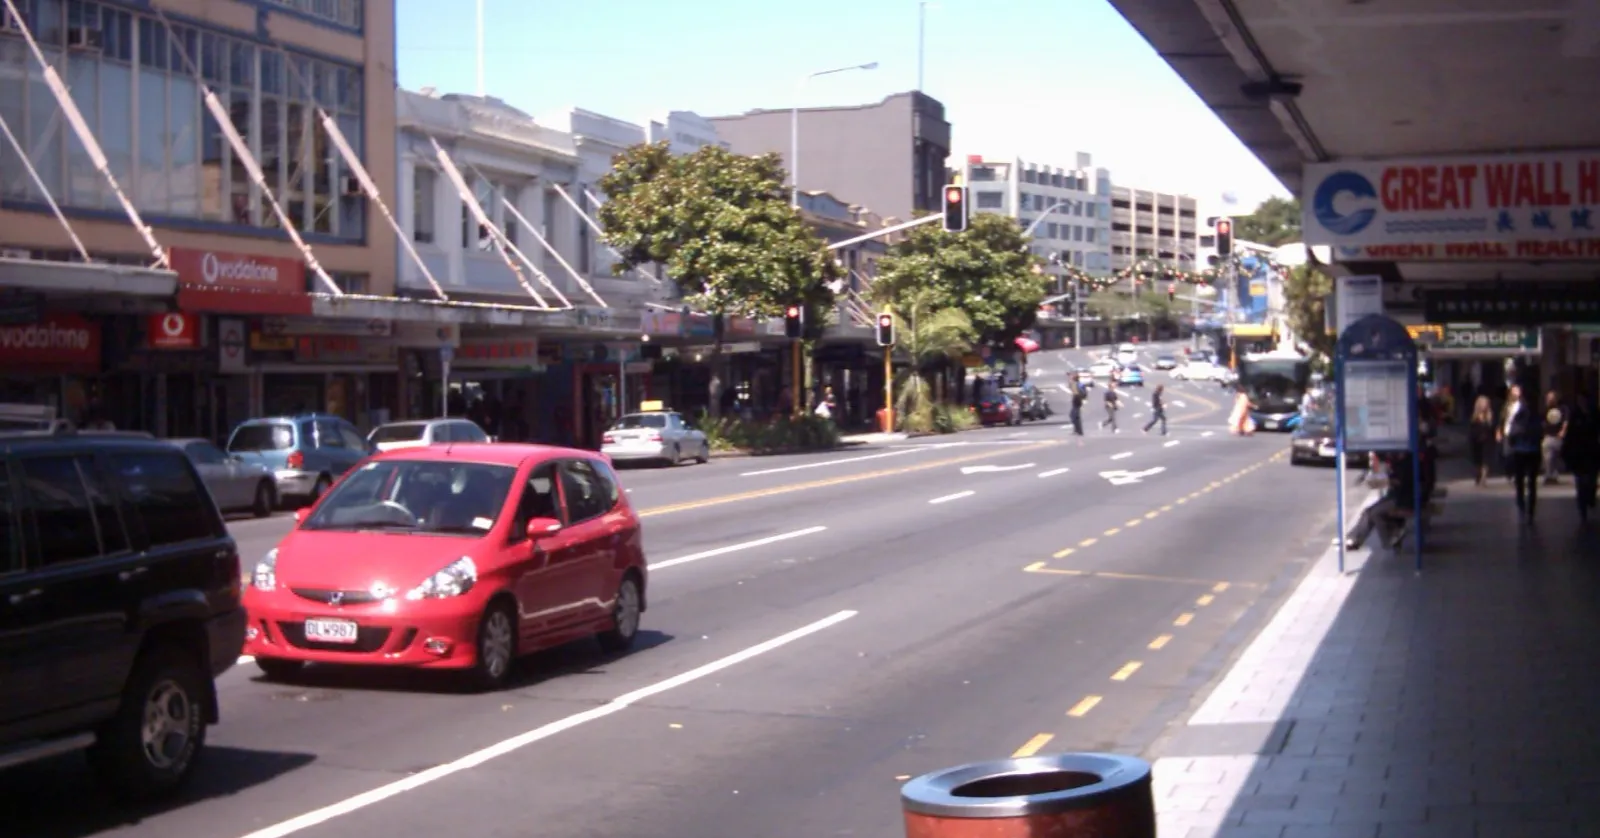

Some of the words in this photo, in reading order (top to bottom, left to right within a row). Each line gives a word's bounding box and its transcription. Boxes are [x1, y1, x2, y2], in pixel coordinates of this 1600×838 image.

[1381, 165, 1477, 212] GREAT
[1485, 163, 1571, 207] WALL
[218, 260, 278, 281] vodafone
[307, 621, 355, 637] DLW987
